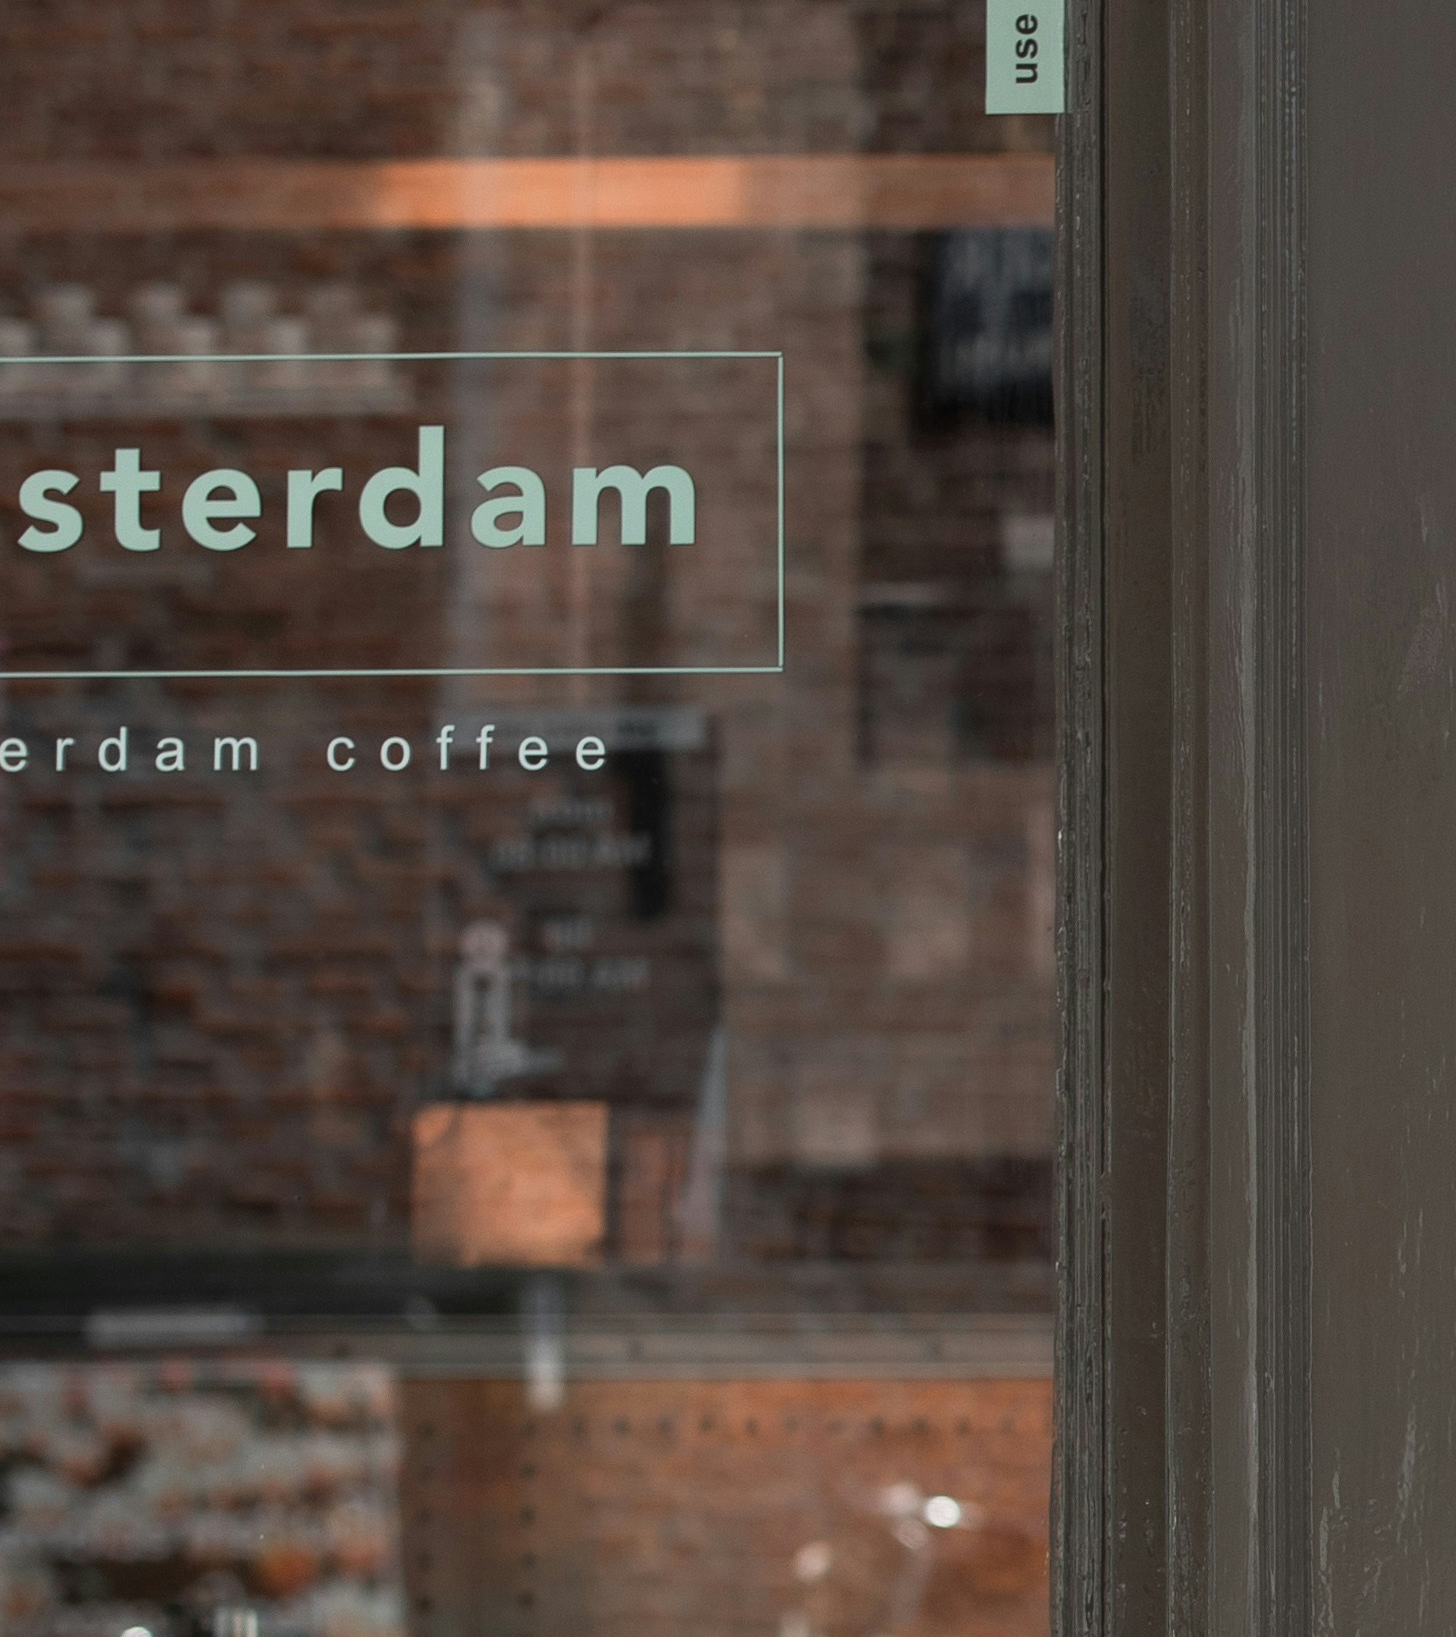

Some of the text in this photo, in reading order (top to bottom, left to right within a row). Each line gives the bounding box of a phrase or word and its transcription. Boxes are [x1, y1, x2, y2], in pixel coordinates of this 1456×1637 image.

[1015, 14, 1039, 85] use
[17, 425, 696, 552] sterdam
[0, 724, 607, 772] erdam coffee
